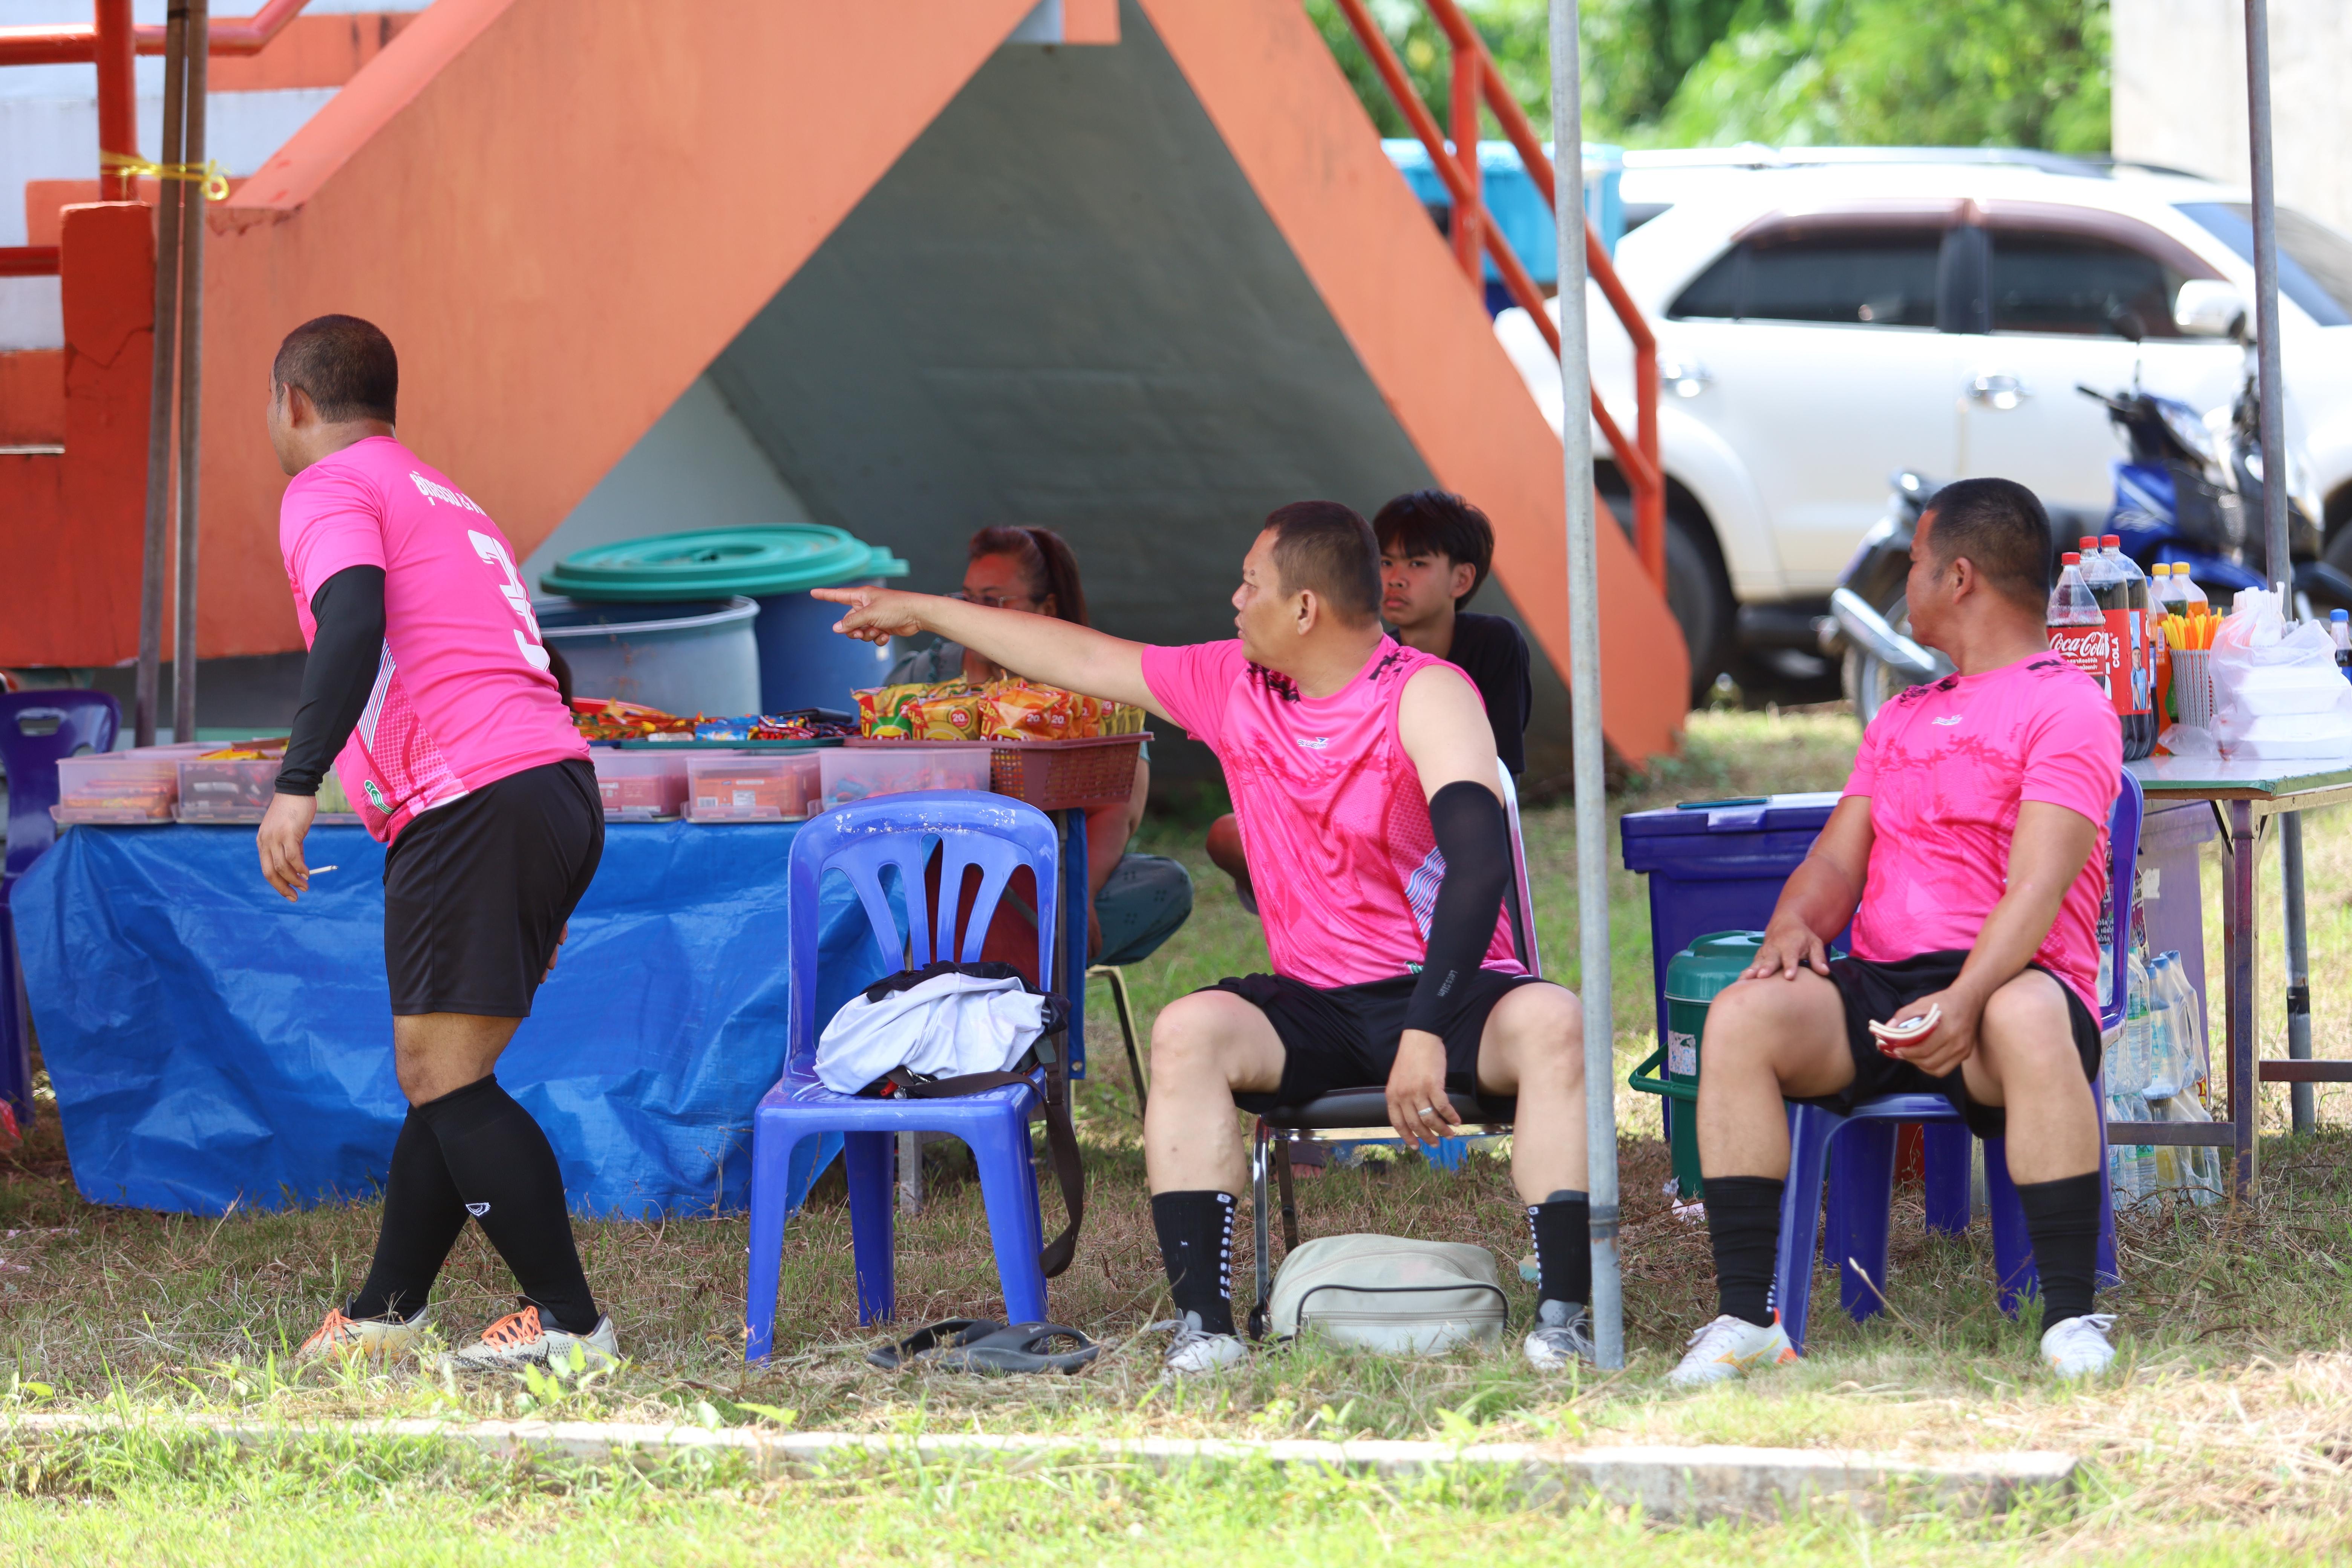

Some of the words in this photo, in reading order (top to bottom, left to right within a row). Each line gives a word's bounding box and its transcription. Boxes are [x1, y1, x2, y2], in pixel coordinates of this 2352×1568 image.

[467, 529, 550, 672] 3
[2049, 631, 2105, 657] Coca-Cola
[2112, 636, 2120, 668] COLA
